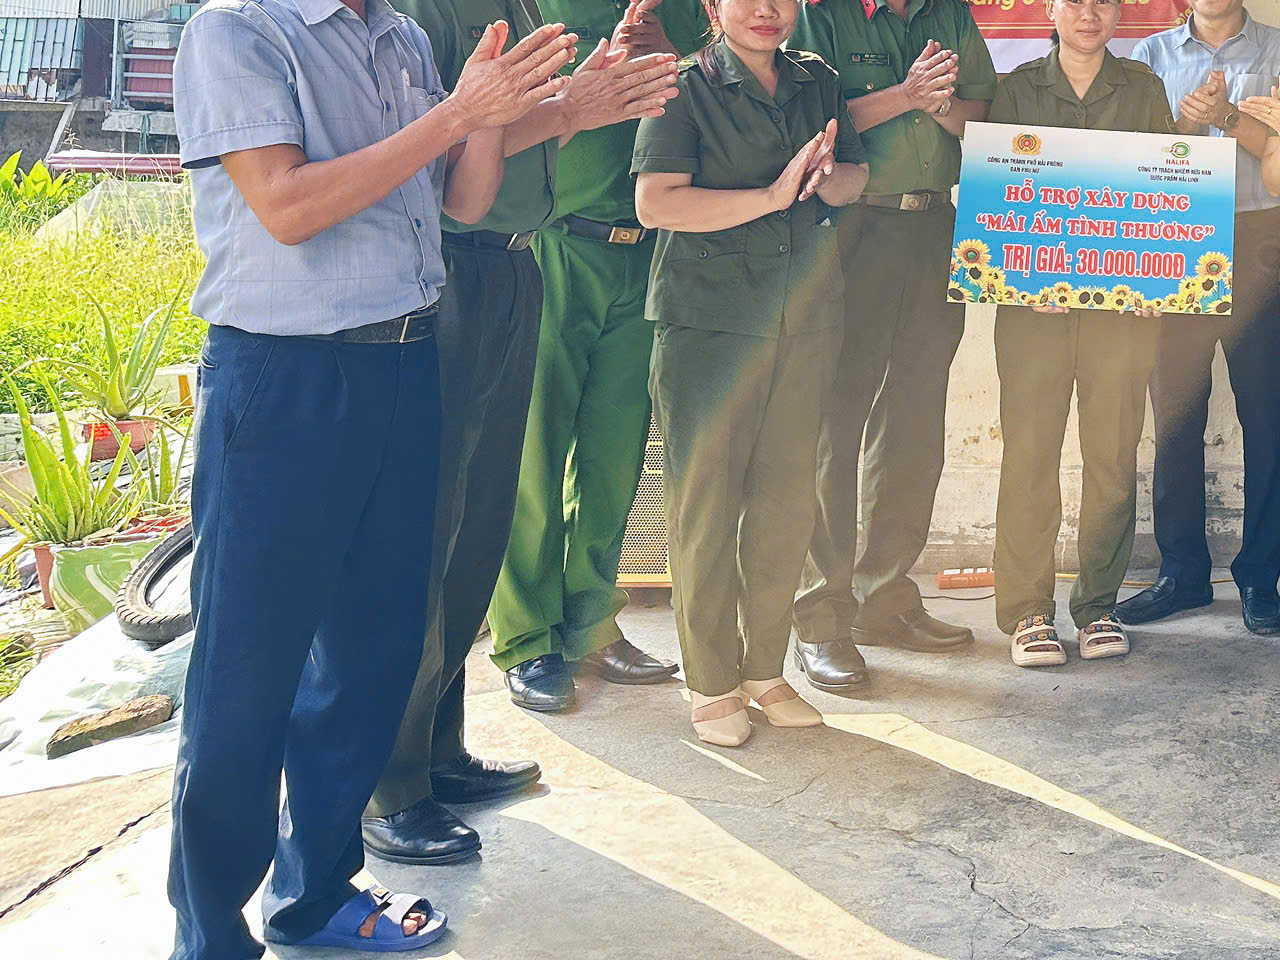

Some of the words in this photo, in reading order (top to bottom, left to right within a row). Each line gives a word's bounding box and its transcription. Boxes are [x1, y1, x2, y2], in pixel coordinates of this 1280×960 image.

[1005, 179, 1034, 204] HỖ
[1039, 187, 1081, 210] TRỢ
[1085, 186, 1128, 208] XÂY
[1132, 190, 1191, 214] DỰNG
[976, 213, 1025, 232] “MÁI
[1031, 210, 1061, 234] ẤM
[1066, 216, 1116, 237] TÌNH
[1121, 221, 1215, 241] THƯƠNG”
[1003, 244, 1032, 276] TRỊ
[1036, 242, 1072, 273] GIÁ:
[1077, 249, 1186, 279] 30.000.000Đ
